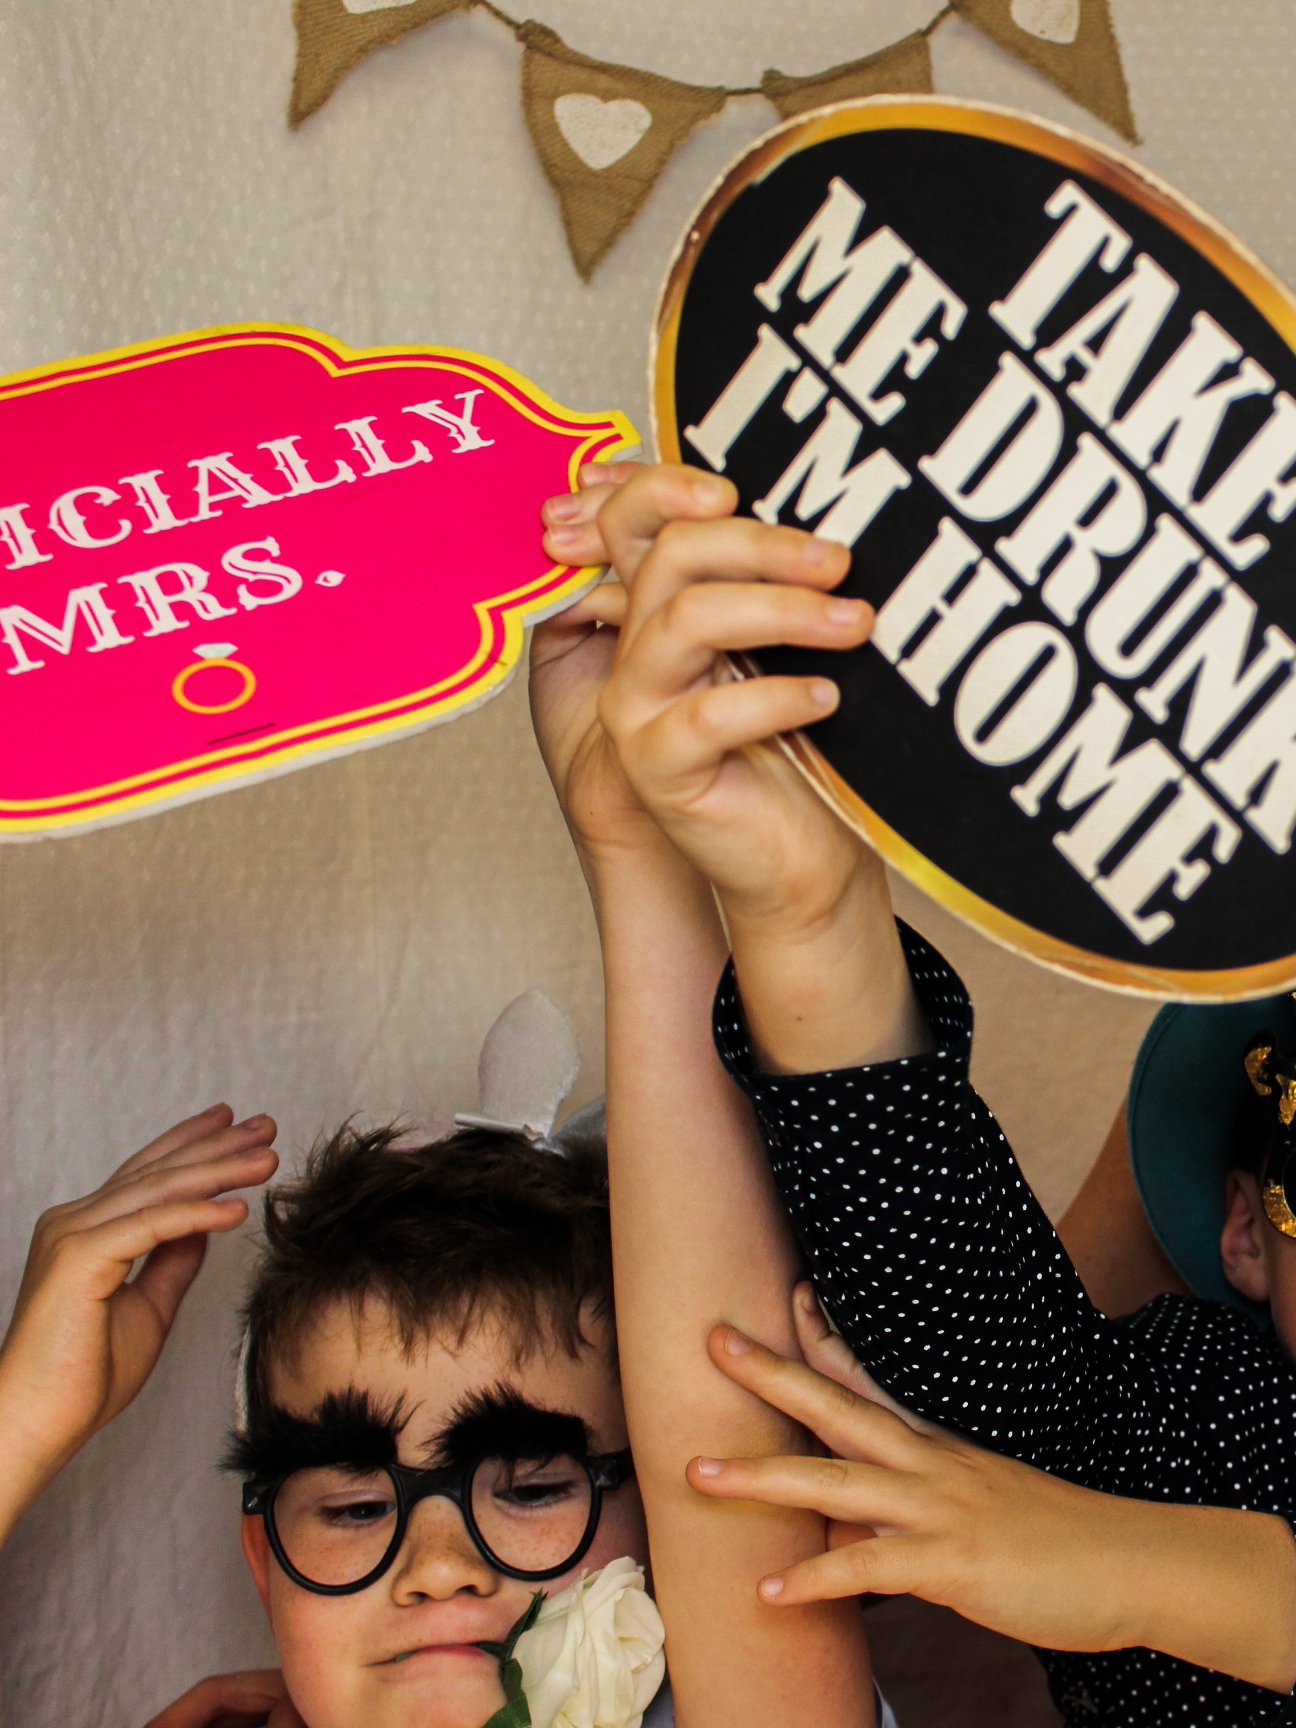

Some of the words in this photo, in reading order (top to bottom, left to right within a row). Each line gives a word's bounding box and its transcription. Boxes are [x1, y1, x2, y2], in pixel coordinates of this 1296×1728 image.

[754, 178, 968, 426] ME
[0, 388, 496, 570] ICIALLY
[0, 535, 346, 675] MRS.
[684, 322, 912, 550] I'M
[870, 515, 1243, 946] HOME
